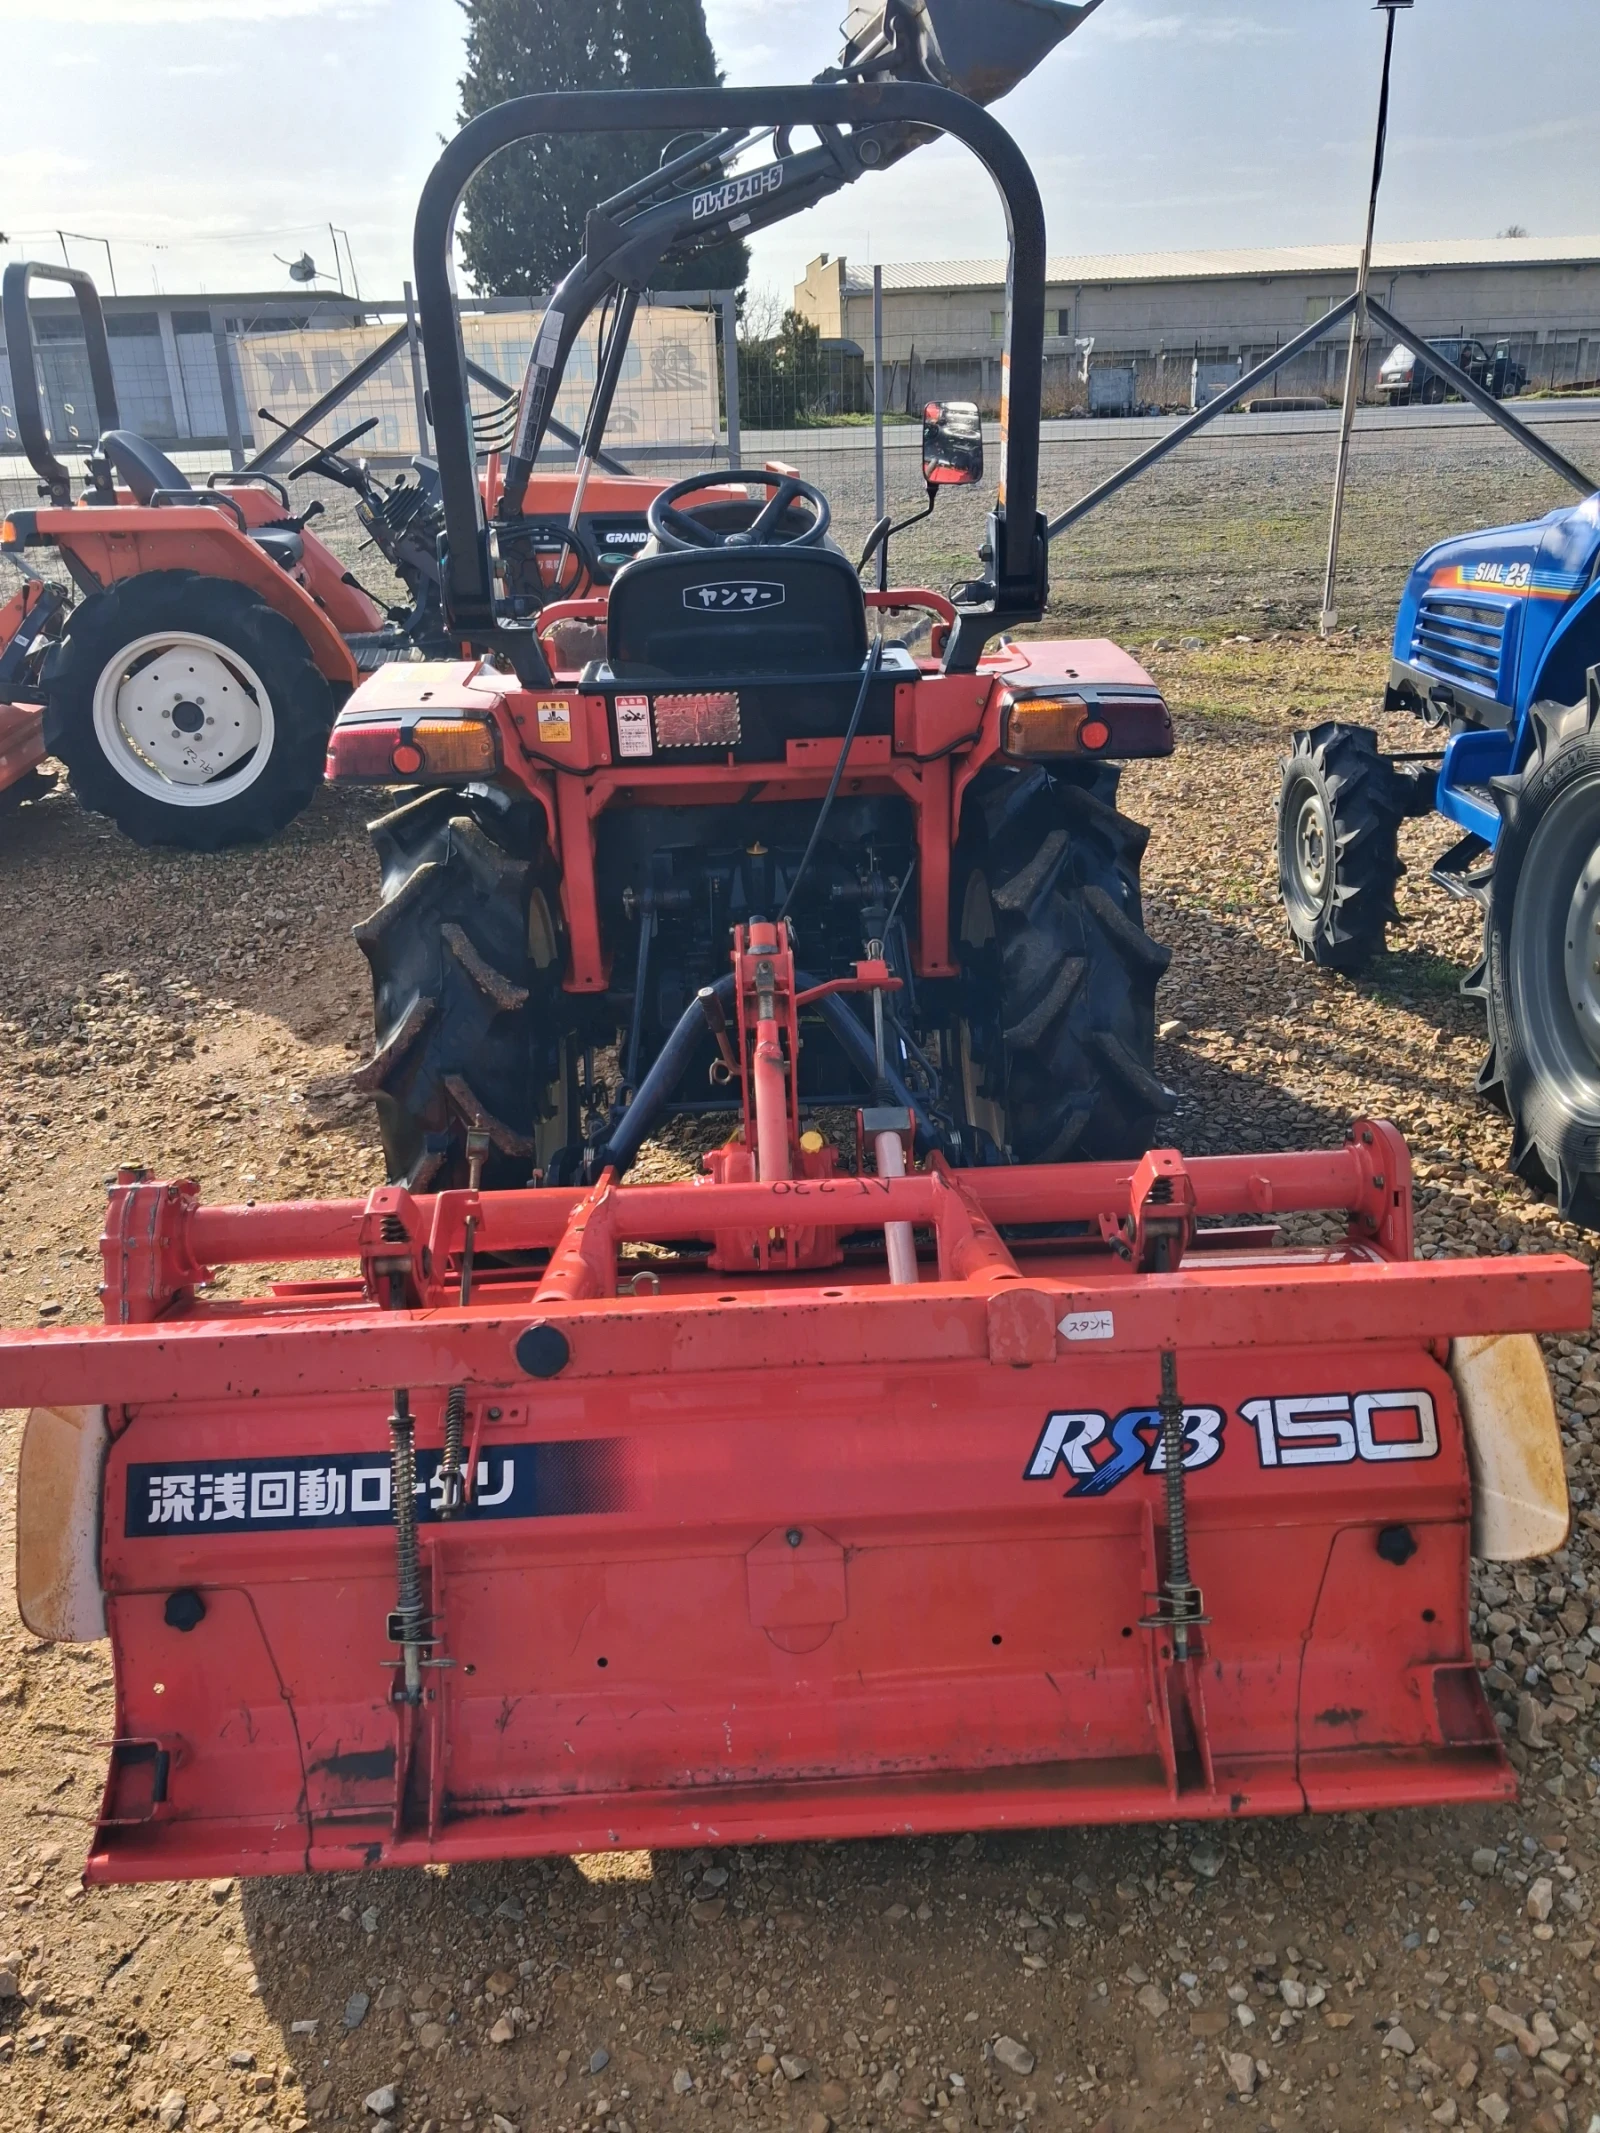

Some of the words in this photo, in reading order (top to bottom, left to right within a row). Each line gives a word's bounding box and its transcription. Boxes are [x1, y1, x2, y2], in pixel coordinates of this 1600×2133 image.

[1474, 562, 1503, 584] SIAL
[1503, 562, 1531, 588] 23
[698, 588, 771, 607] ヤンマー
[1069, 1319, 1111, 1332] スタンド
[1024, 1404, 1226, 1497] RSB
[1236, 1388, 1440, 1469] 150
